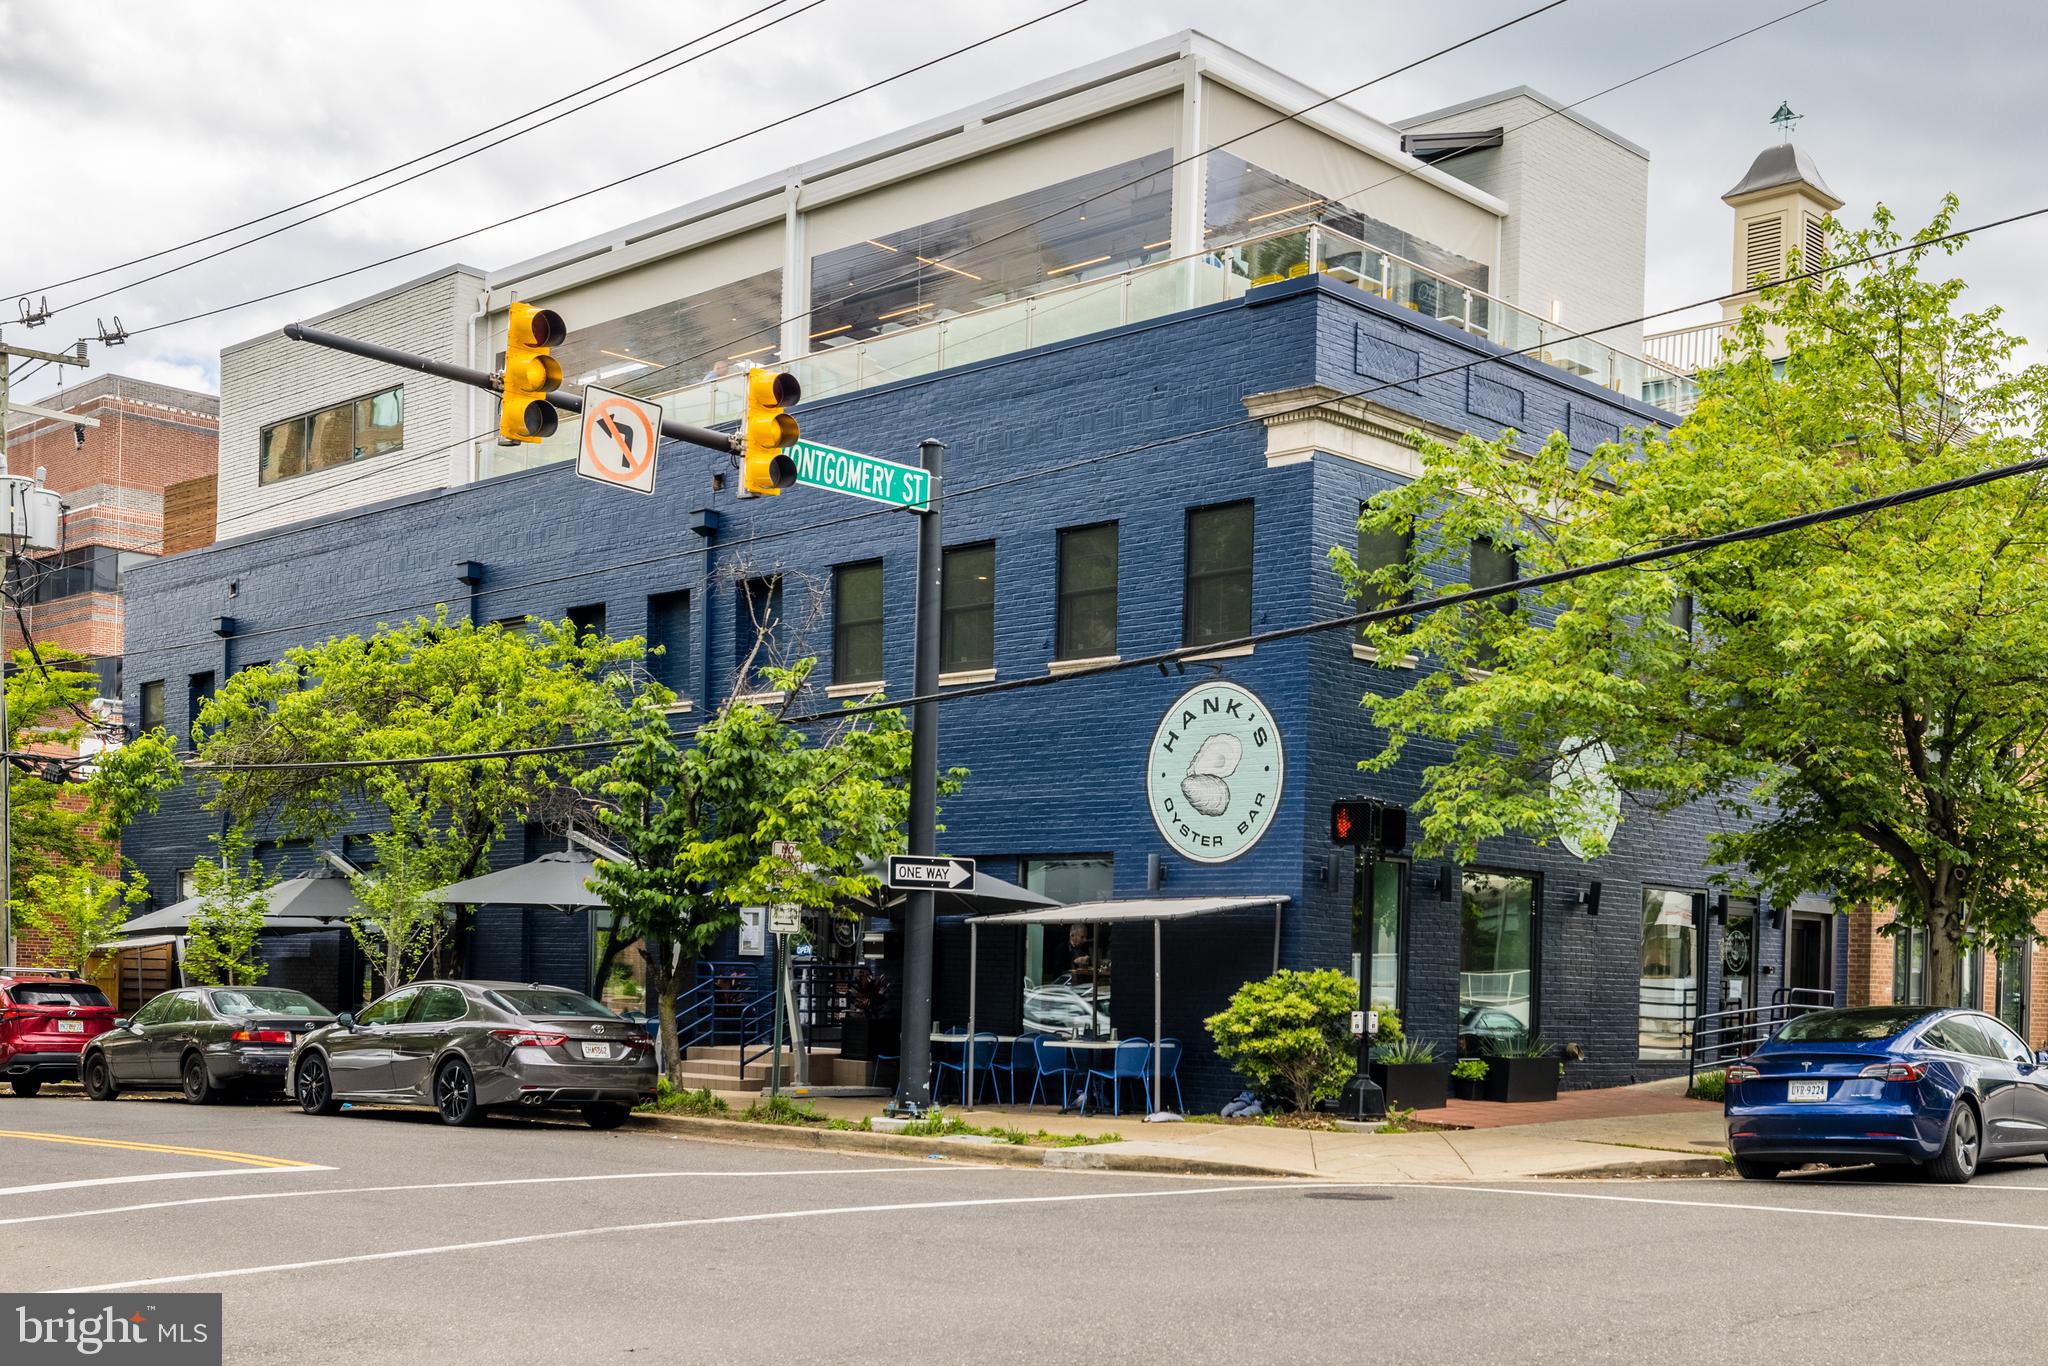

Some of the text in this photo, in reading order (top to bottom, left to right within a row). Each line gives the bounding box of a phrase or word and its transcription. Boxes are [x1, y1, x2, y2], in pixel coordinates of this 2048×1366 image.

[902, 472, 923, 503] ST
[1163, 697, 1268, 753] HANK'S
[1164, 792, 1266, 847] OYSTER BAR
[899, 866, 949, 880] ONE WAY
